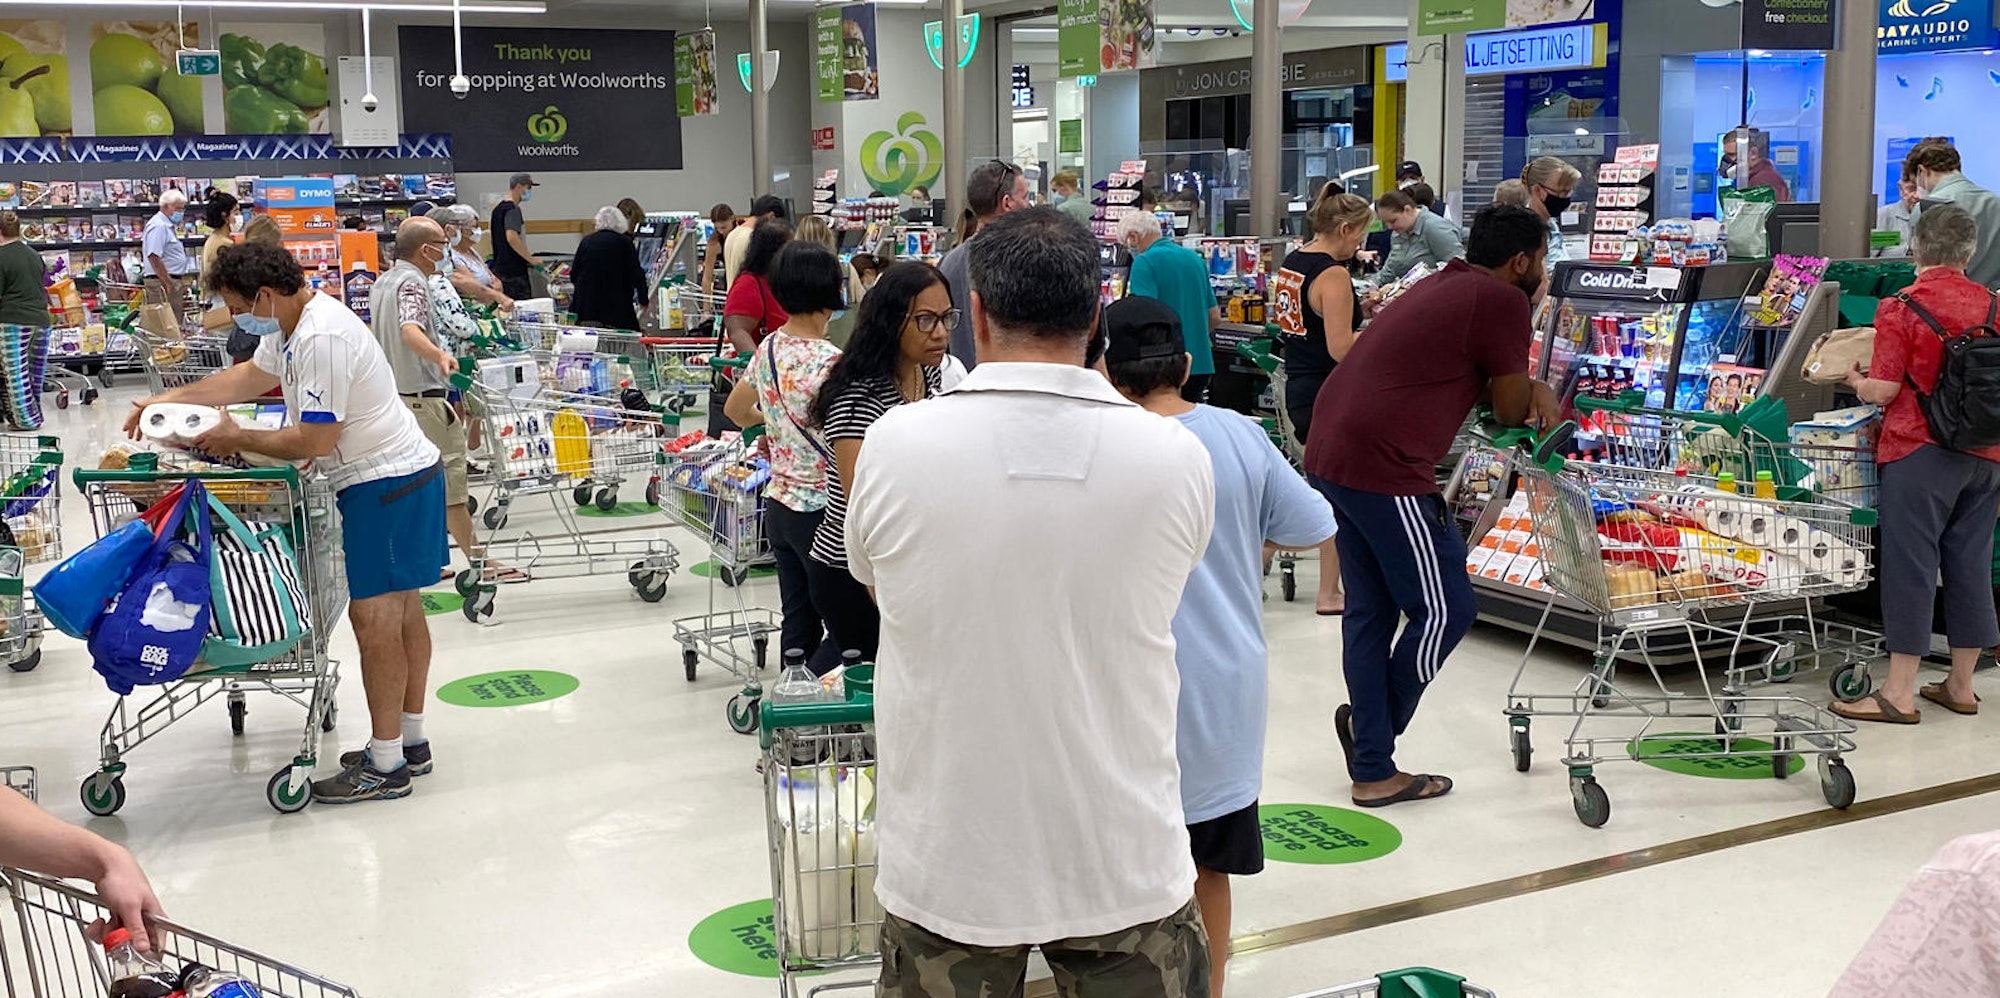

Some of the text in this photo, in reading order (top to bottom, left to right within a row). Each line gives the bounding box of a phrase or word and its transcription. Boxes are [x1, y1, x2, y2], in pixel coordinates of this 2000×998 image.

[1061, 15, 1076, 27] with
[1765, 11, 1828, 23] free checkout
[933, 30, 942, 49] 6
[962, 24, 969, 43] 5
[494, 43, 592, 65] Thank you
[1481, 33, 1574, 67] JETSETTING
[416, 70, 445, 87] for
[537, 73, 556, 88] at
[559, 72, 666, 89] Woolworths
[1191, 72, 1223, 91] JON
[1227, 63, 1306, 88] CRBIE
[96, 144, 140, 154] Magazines
[196, 142, 238, 152] Magazines
[518, 144, 579, 156] woolworths
[299, 189, 332, 198] DYMO
[1580, 272, 1611, 288] Cold
[140, 652, 169, 666] BAG
[142, 644, 169, 655] COOL
[466, 682, 496, 700] here
[487, 678, 530, 700] stand
[508, 673, 546, 697] Please
[1264, 816, 1348, 850] stand
[1285, 809, 1369, 848] Please
[730, 923, 778, 960] here
